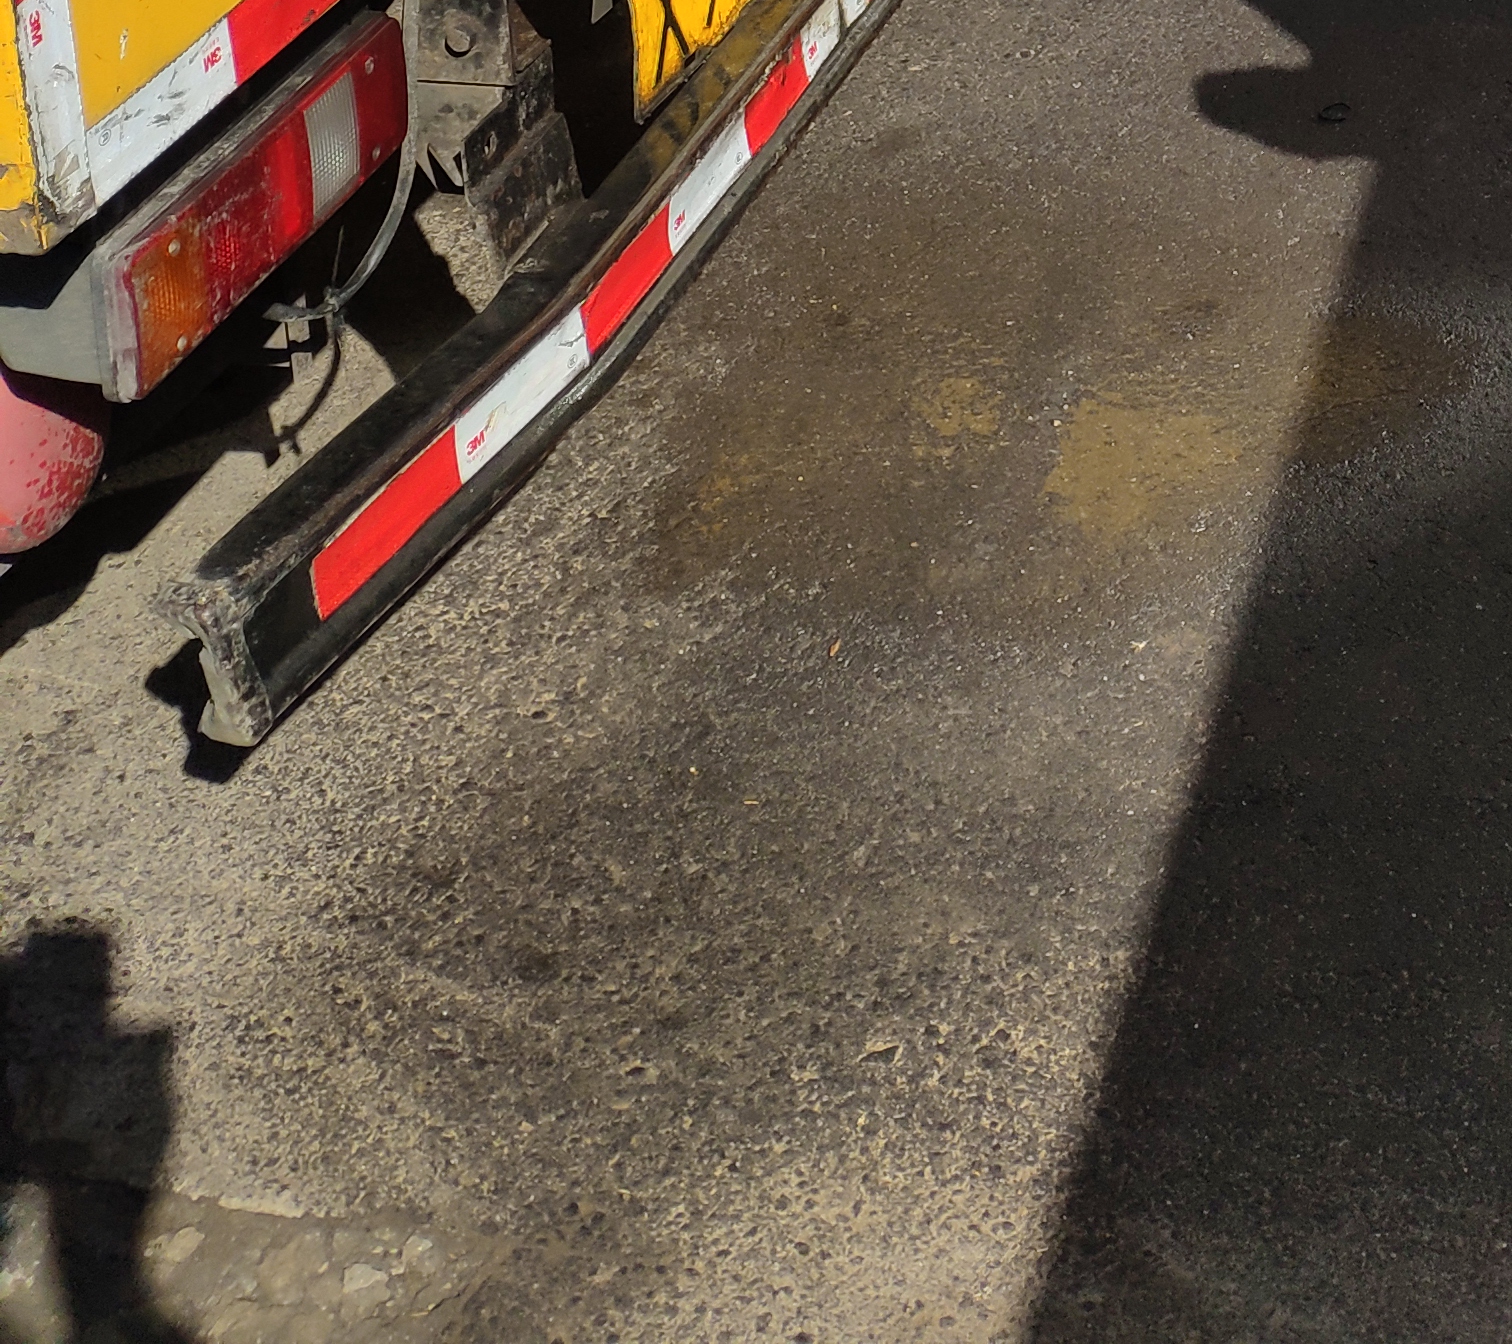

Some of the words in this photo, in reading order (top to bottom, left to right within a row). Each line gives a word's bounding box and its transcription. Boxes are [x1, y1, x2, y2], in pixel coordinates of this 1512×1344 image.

[28, 9, 43, 47] 3M
[202, 46, 222, 73] 3M
[808, 41, 818, 60] 3M
[466, 430, 486, 456] 3M
